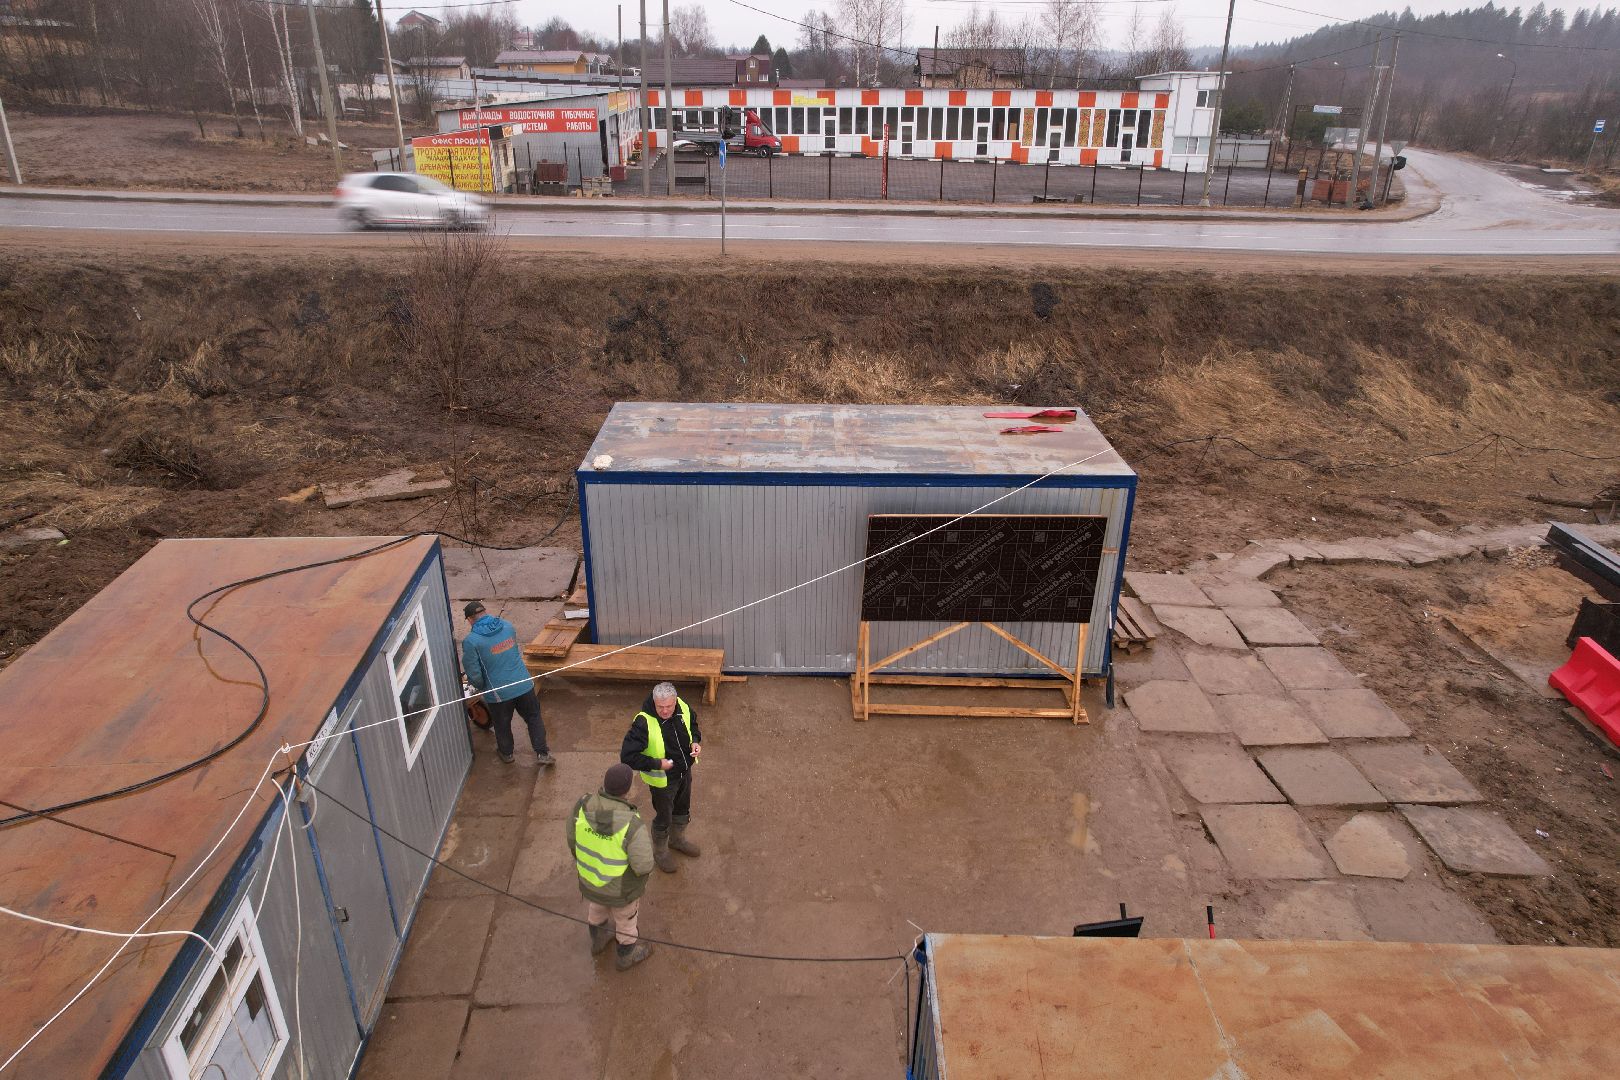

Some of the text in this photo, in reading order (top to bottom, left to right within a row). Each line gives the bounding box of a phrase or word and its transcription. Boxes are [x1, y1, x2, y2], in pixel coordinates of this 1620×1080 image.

[509, 110, 555, 120] ВОДОСТОЧНАЯ
[561, 110, 596, 119] ГИБОЧНЫЕ
[522, 121, 548, 131] ИСТЕМА
[566, 121, 592, 131] РАБОТЫ
[454, 138, 487, 146] ПРОДАЖ
[460, 147, 487, 156] ПЛИТА
[462, 163, 490, 171] РАБОЫ
